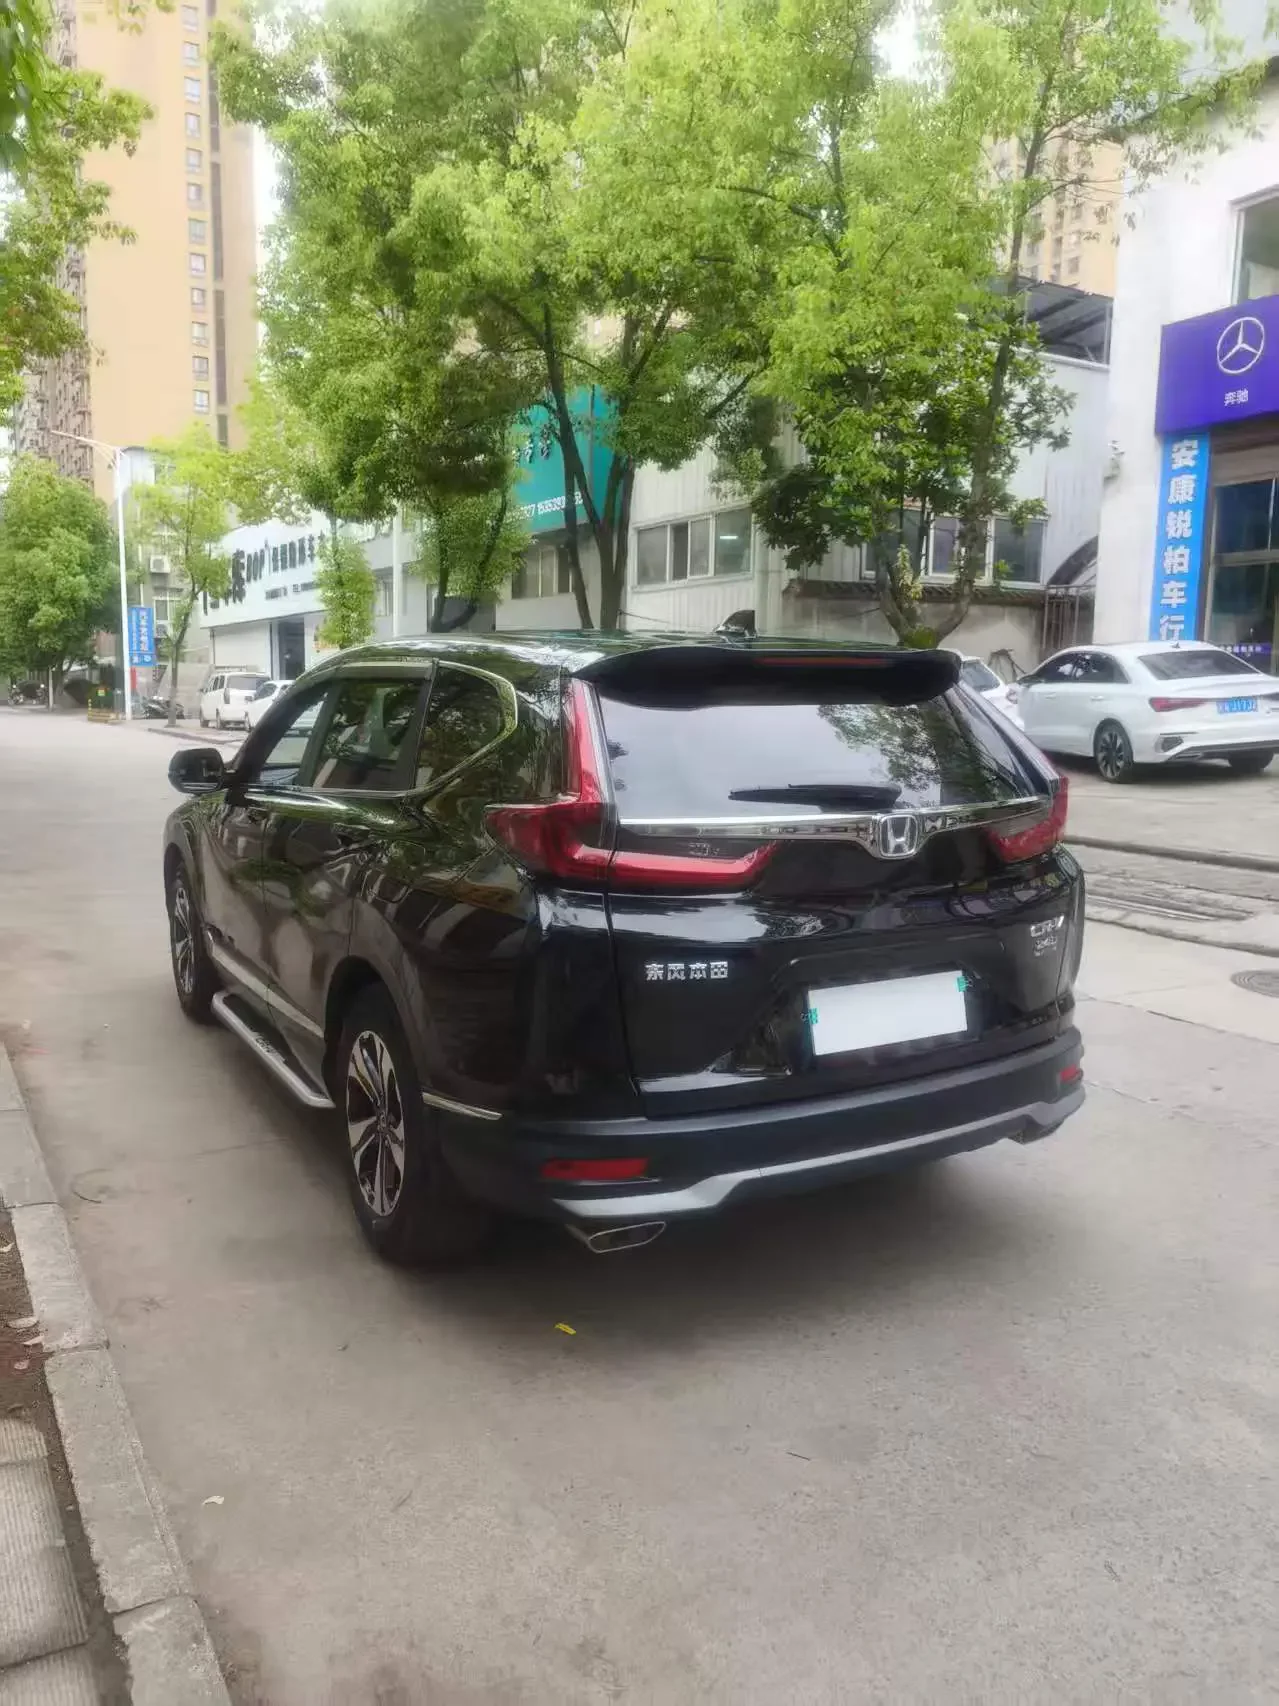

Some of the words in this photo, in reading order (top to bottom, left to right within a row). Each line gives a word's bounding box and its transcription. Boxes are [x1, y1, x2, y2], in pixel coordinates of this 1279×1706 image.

[1224, 388, 1249, 406] 奔驰
[1159, 439, 1198, 641] 安康锐柏车行
[645, 961, 728, 981] 东风本田
